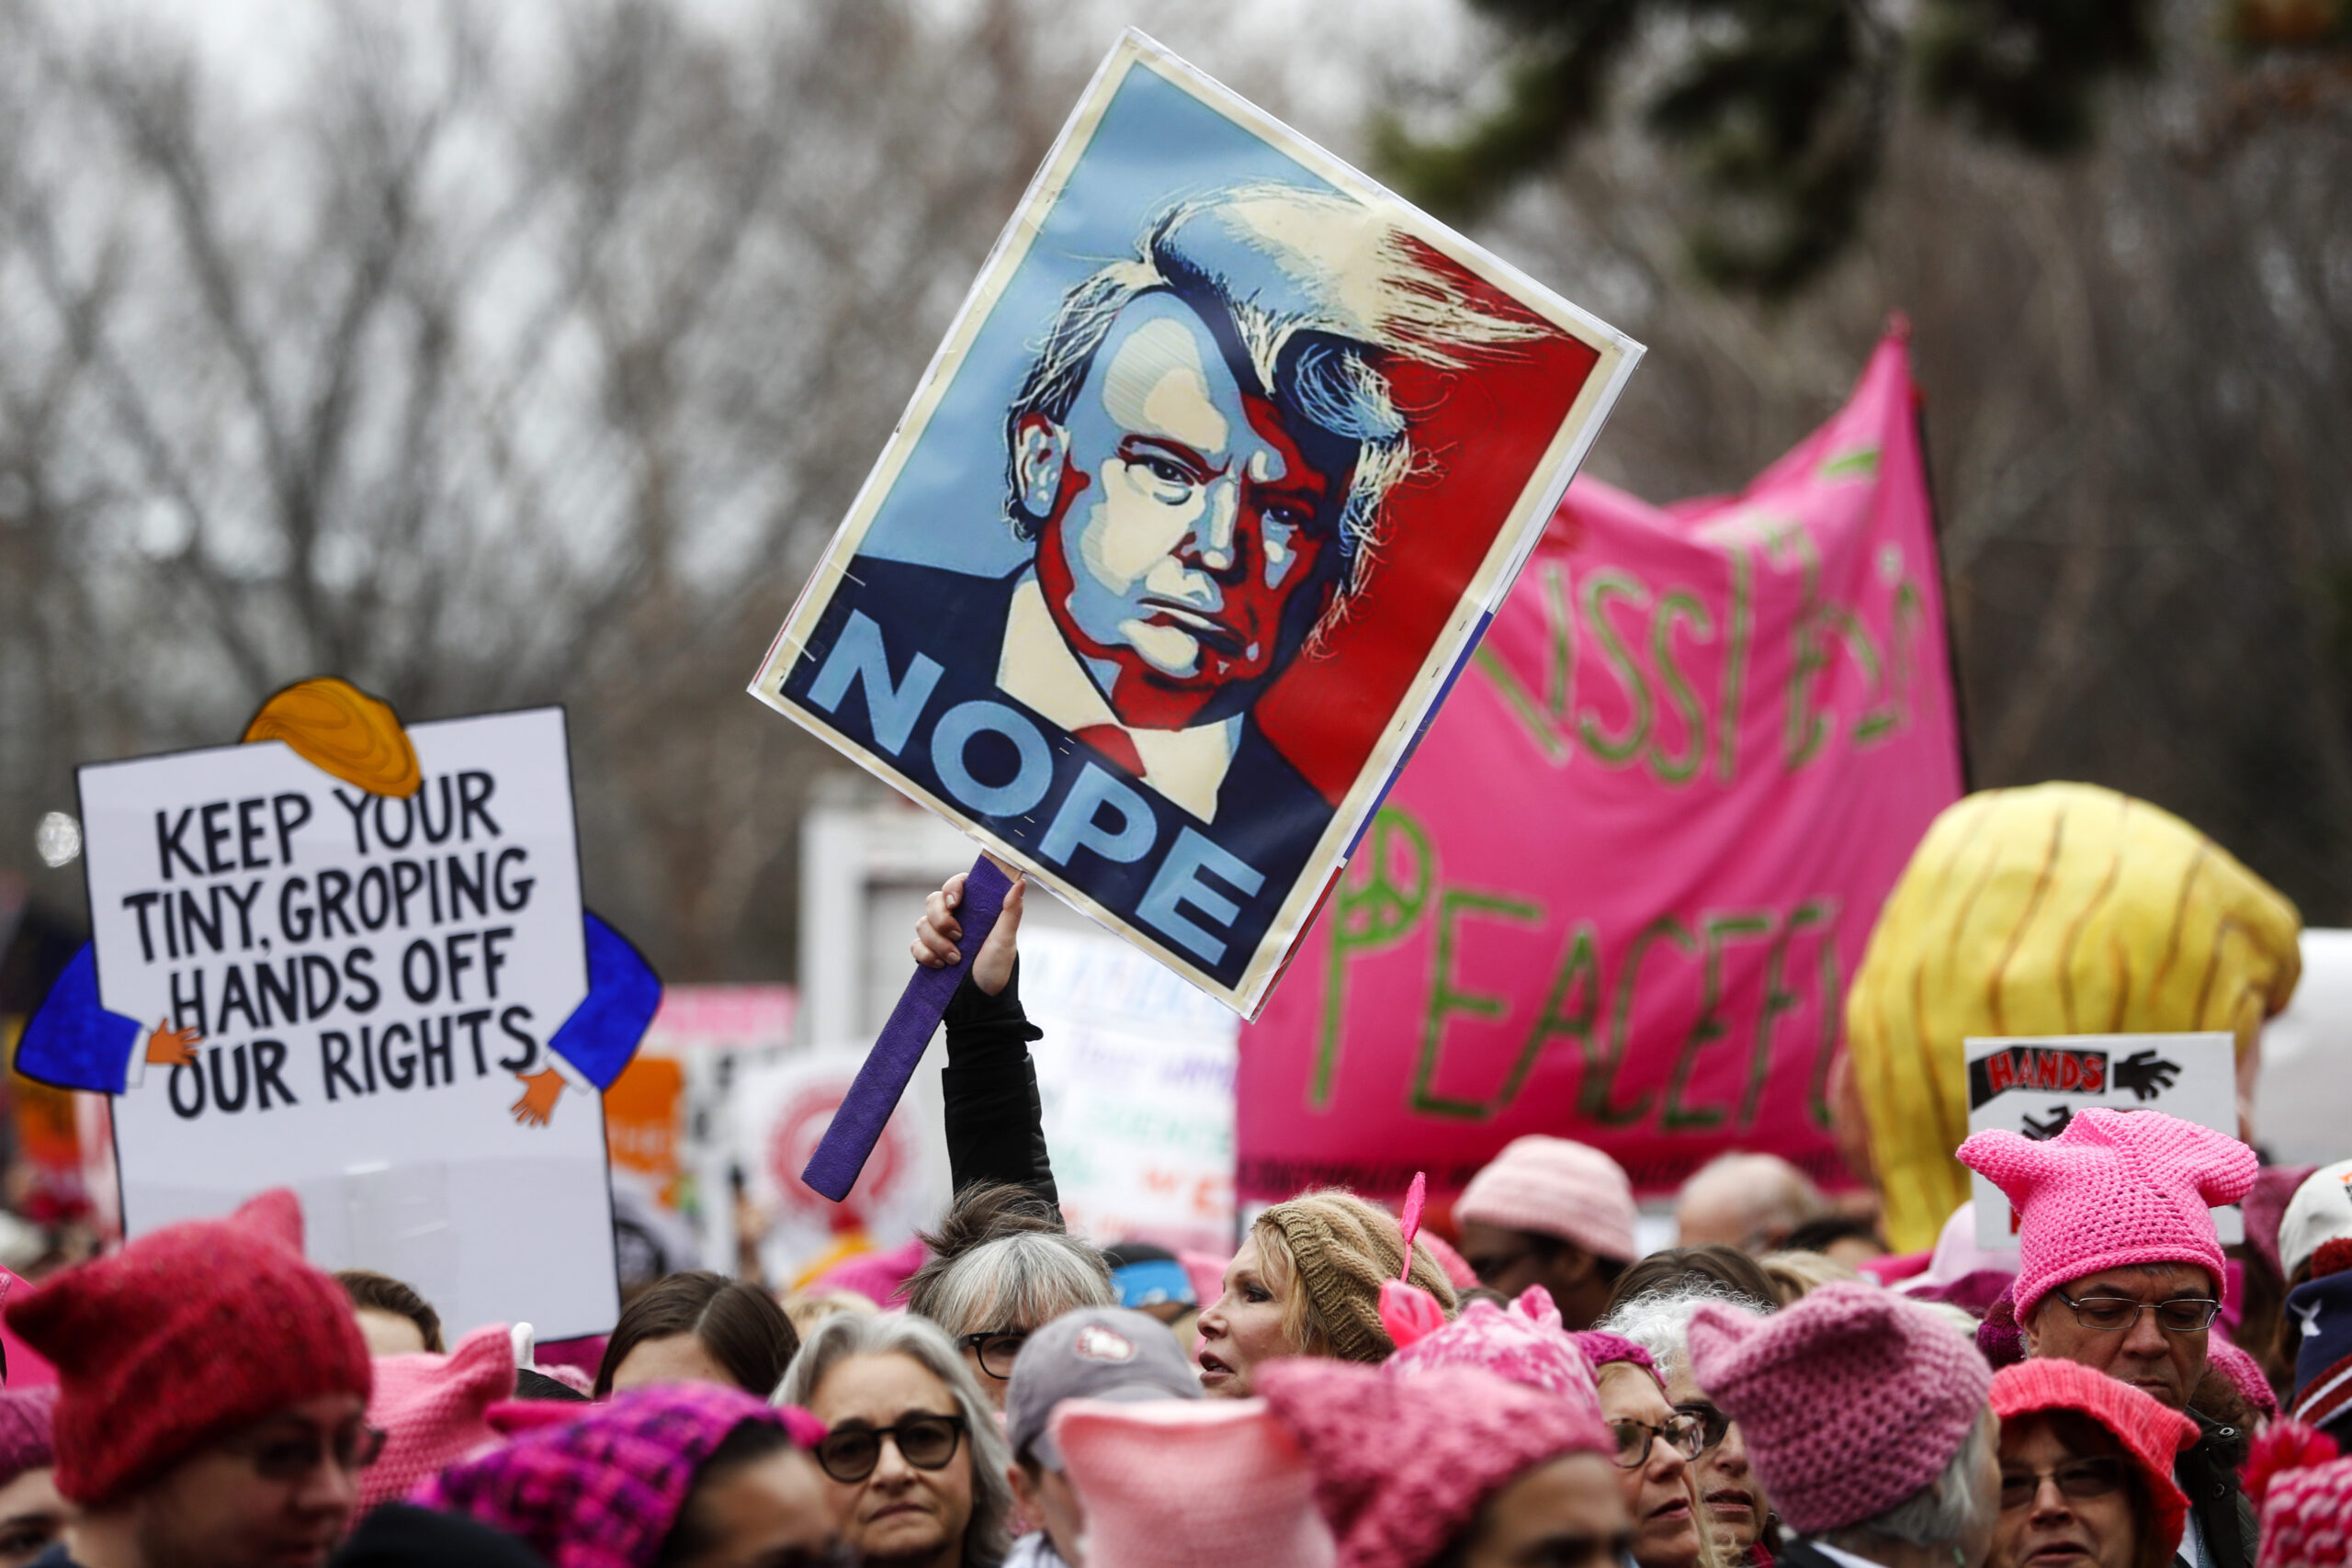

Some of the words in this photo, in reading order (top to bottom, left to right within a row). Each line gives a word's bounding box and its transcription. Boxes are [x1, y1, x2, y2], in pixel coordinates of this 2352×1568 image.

[155, 792, 311, 880] KEEP
[332, 770, 500, 855] YOUR
[806, 608, 1266, 966] NOPE
[278, 846, 535, 944] GROPING
[170, 947, 380, 1039] HANDS
[401, 927, 514, 1003] OFF
[168, 1039, 298, 1119] OUR
[320, 1006, 537, 1100] RIGHTS
[1985, 1048, 2106, 1093] HANDS
